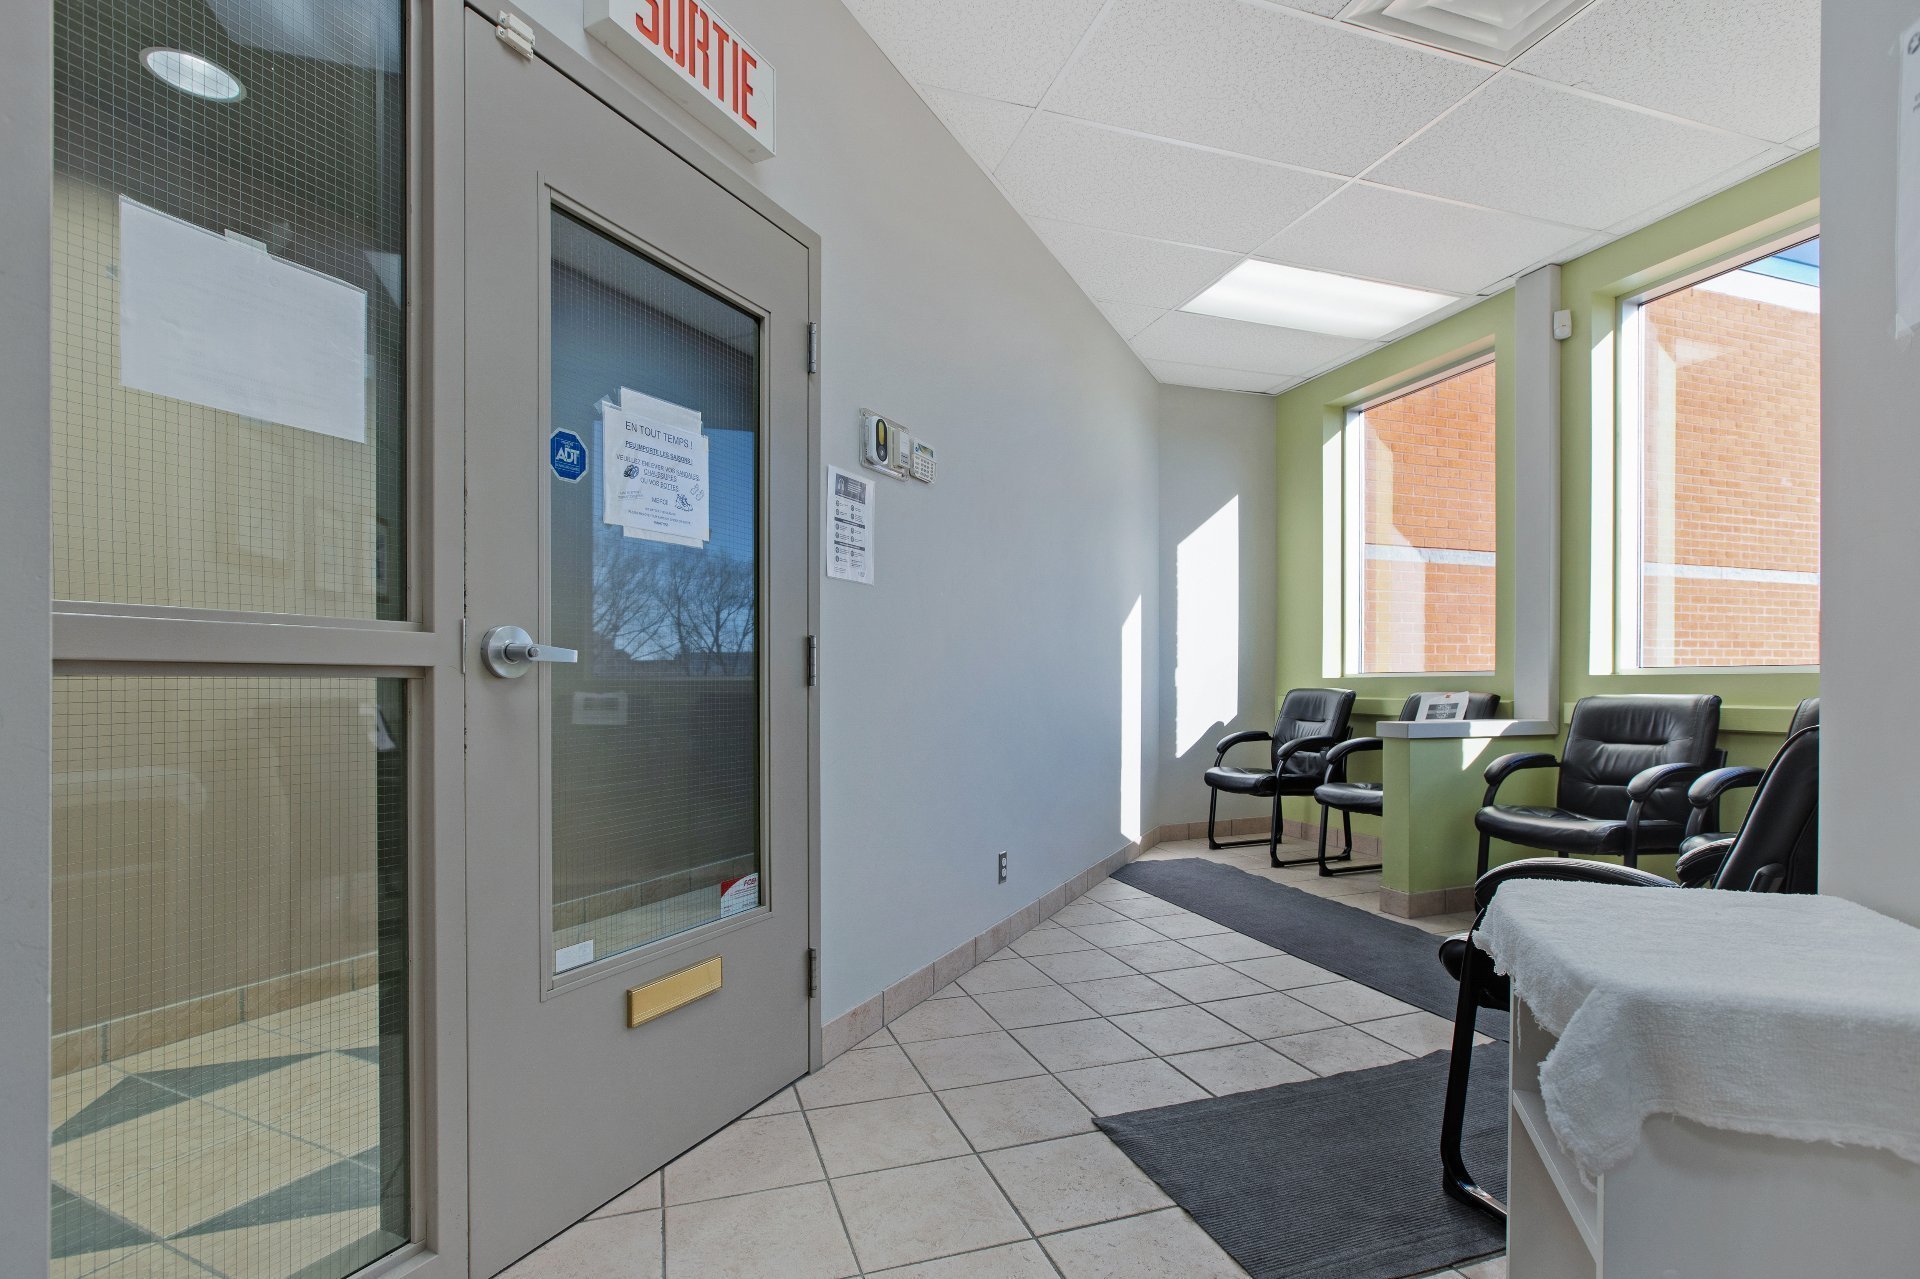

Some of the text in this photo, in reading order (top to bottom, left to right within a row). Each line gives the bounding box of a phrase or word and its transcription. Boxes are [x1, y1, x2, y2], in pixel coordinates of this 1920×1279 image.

[625, 420, 638, 433] EN
[639, 425, 661, 440] TOUT
[663, 432, 689, 449] TEMPS
[555, 446, 580, 465] ADT
